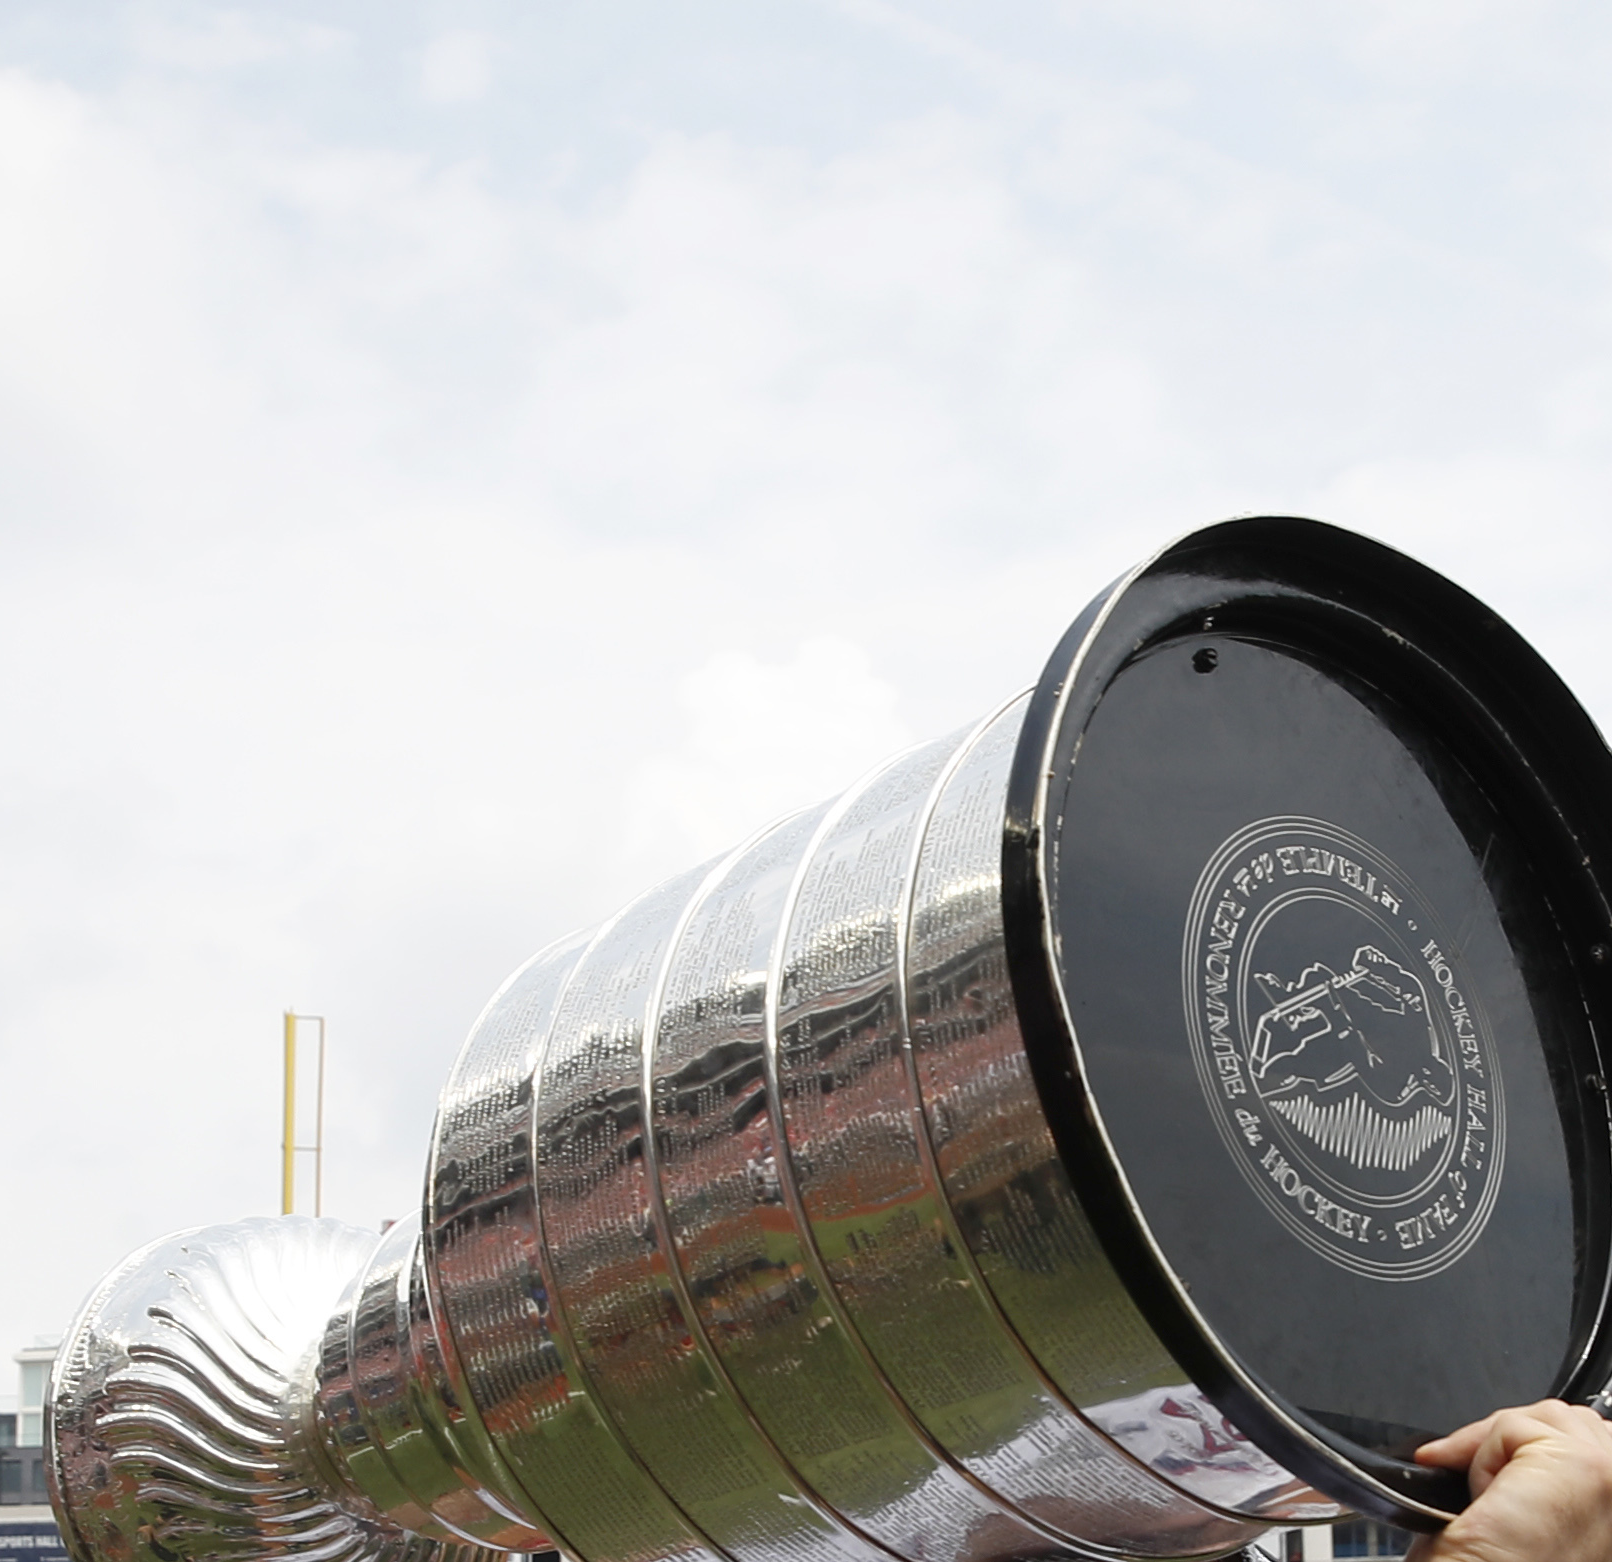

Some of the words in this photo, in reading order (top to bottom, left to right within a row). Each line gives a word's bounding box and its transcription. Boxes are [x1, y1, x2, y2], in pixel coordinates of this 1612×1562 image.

[1275, 846, 1379, 903] TEMPLE
[1205, 888, 1247, 1099] RENOMMÉE
[1420, 939, 1484, 1079] HOCKEY
[1234, 1108, 1263, 1147] du
[1460, 1083, 1487, 1170] HALL
[1260, 1143, 1372, 1243] HOCKEY
[1394, 1194, 1459, 1250] FAME
[35, 1534, 59, 1548] HALL
